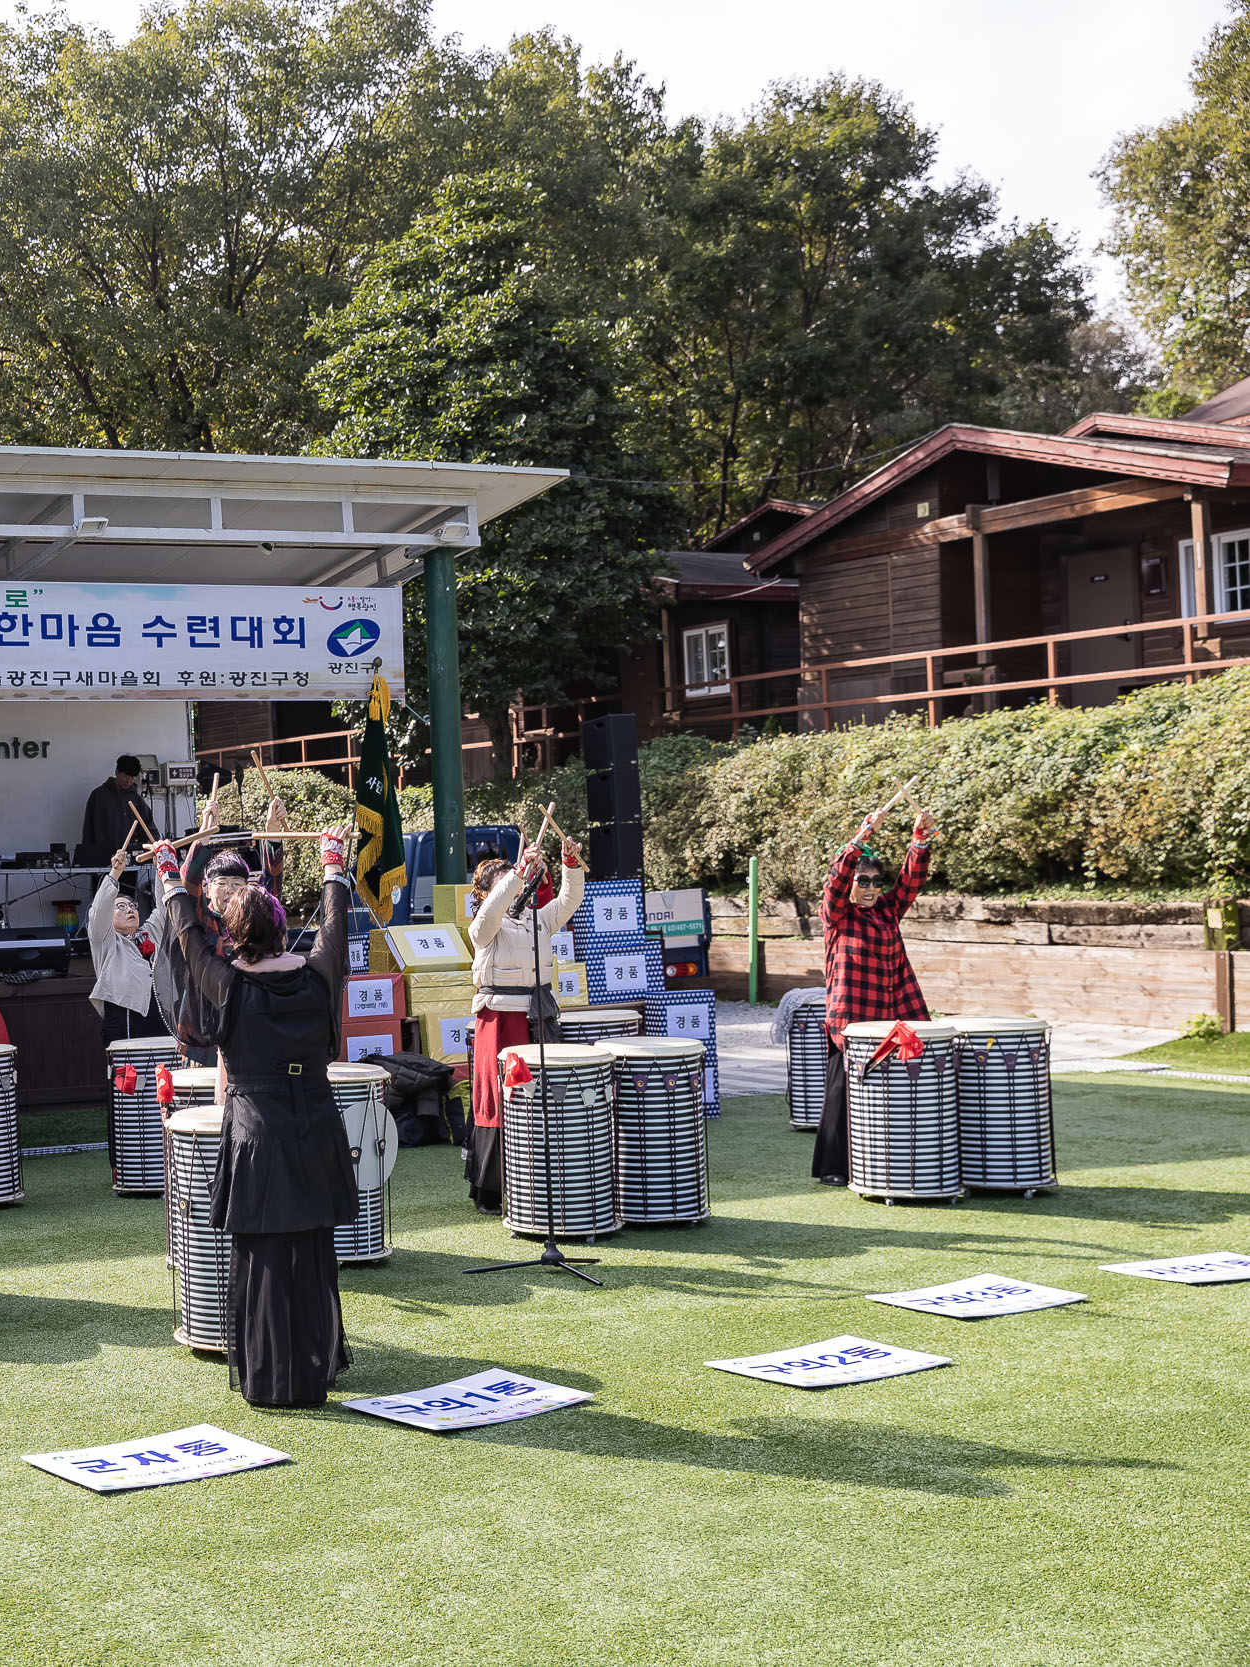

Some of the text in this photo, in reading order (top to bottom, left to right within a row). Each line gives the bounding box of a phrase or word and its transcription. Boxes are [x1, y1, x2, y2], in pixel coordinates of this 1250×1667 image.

[141, 614, 306, 649] 수련대회
[177, 670, 309, 687] 후원:광진구청
[327, 662, 374, 674] 광진구
[645, 911, 675, 921] NDAI
[906, 1283, 1032, 1307] 구의3동
[748, 1346, 892, 1374] 구의2동
[383, 1380, 537, 1416] 구의1동
[70, 1439, 229, 1474] 군자동
